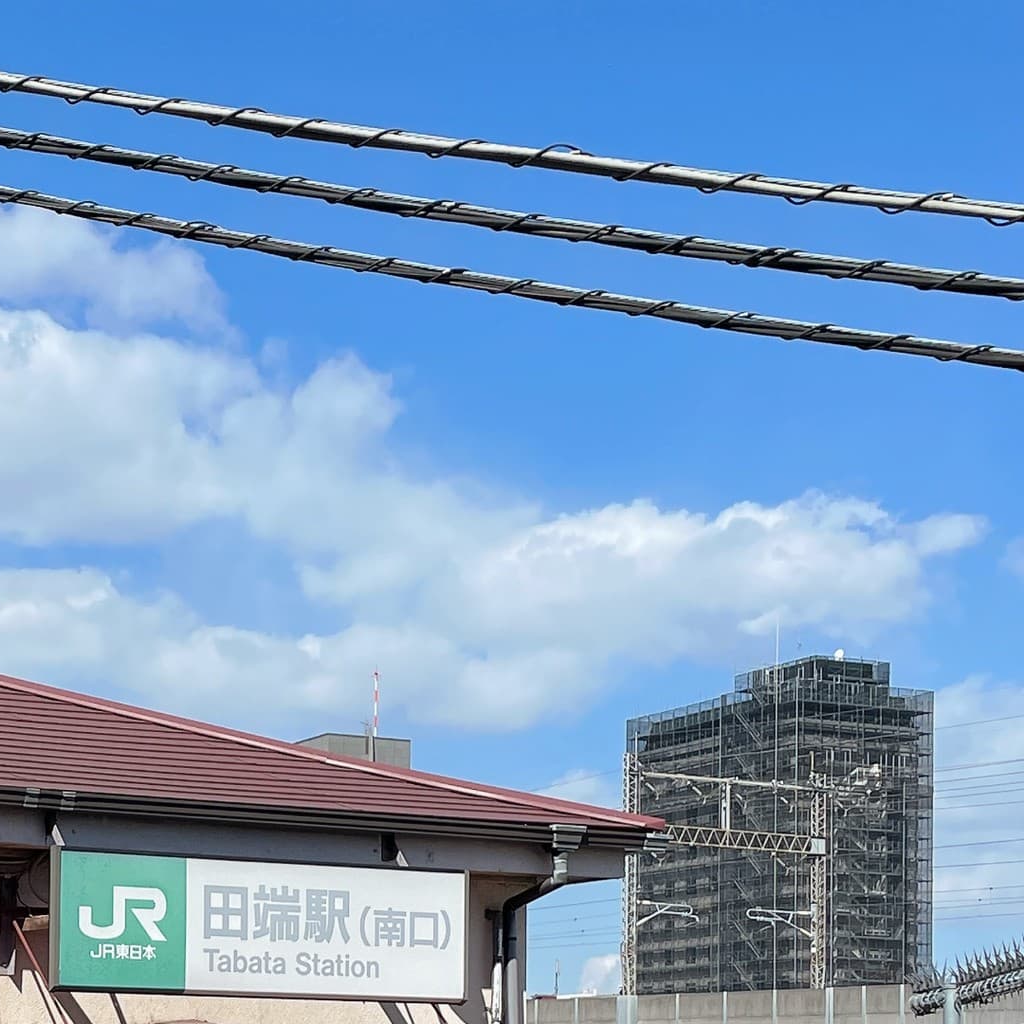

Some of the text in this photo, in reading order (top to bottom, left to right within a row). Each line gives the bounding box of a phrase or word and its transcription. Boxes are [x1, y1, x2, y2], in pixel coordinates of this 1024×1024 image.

[79, 885, 167, 942] JR
[90, 943, 157, 960] JR東日本
[203, 947, 380, 978] Tabata Station
